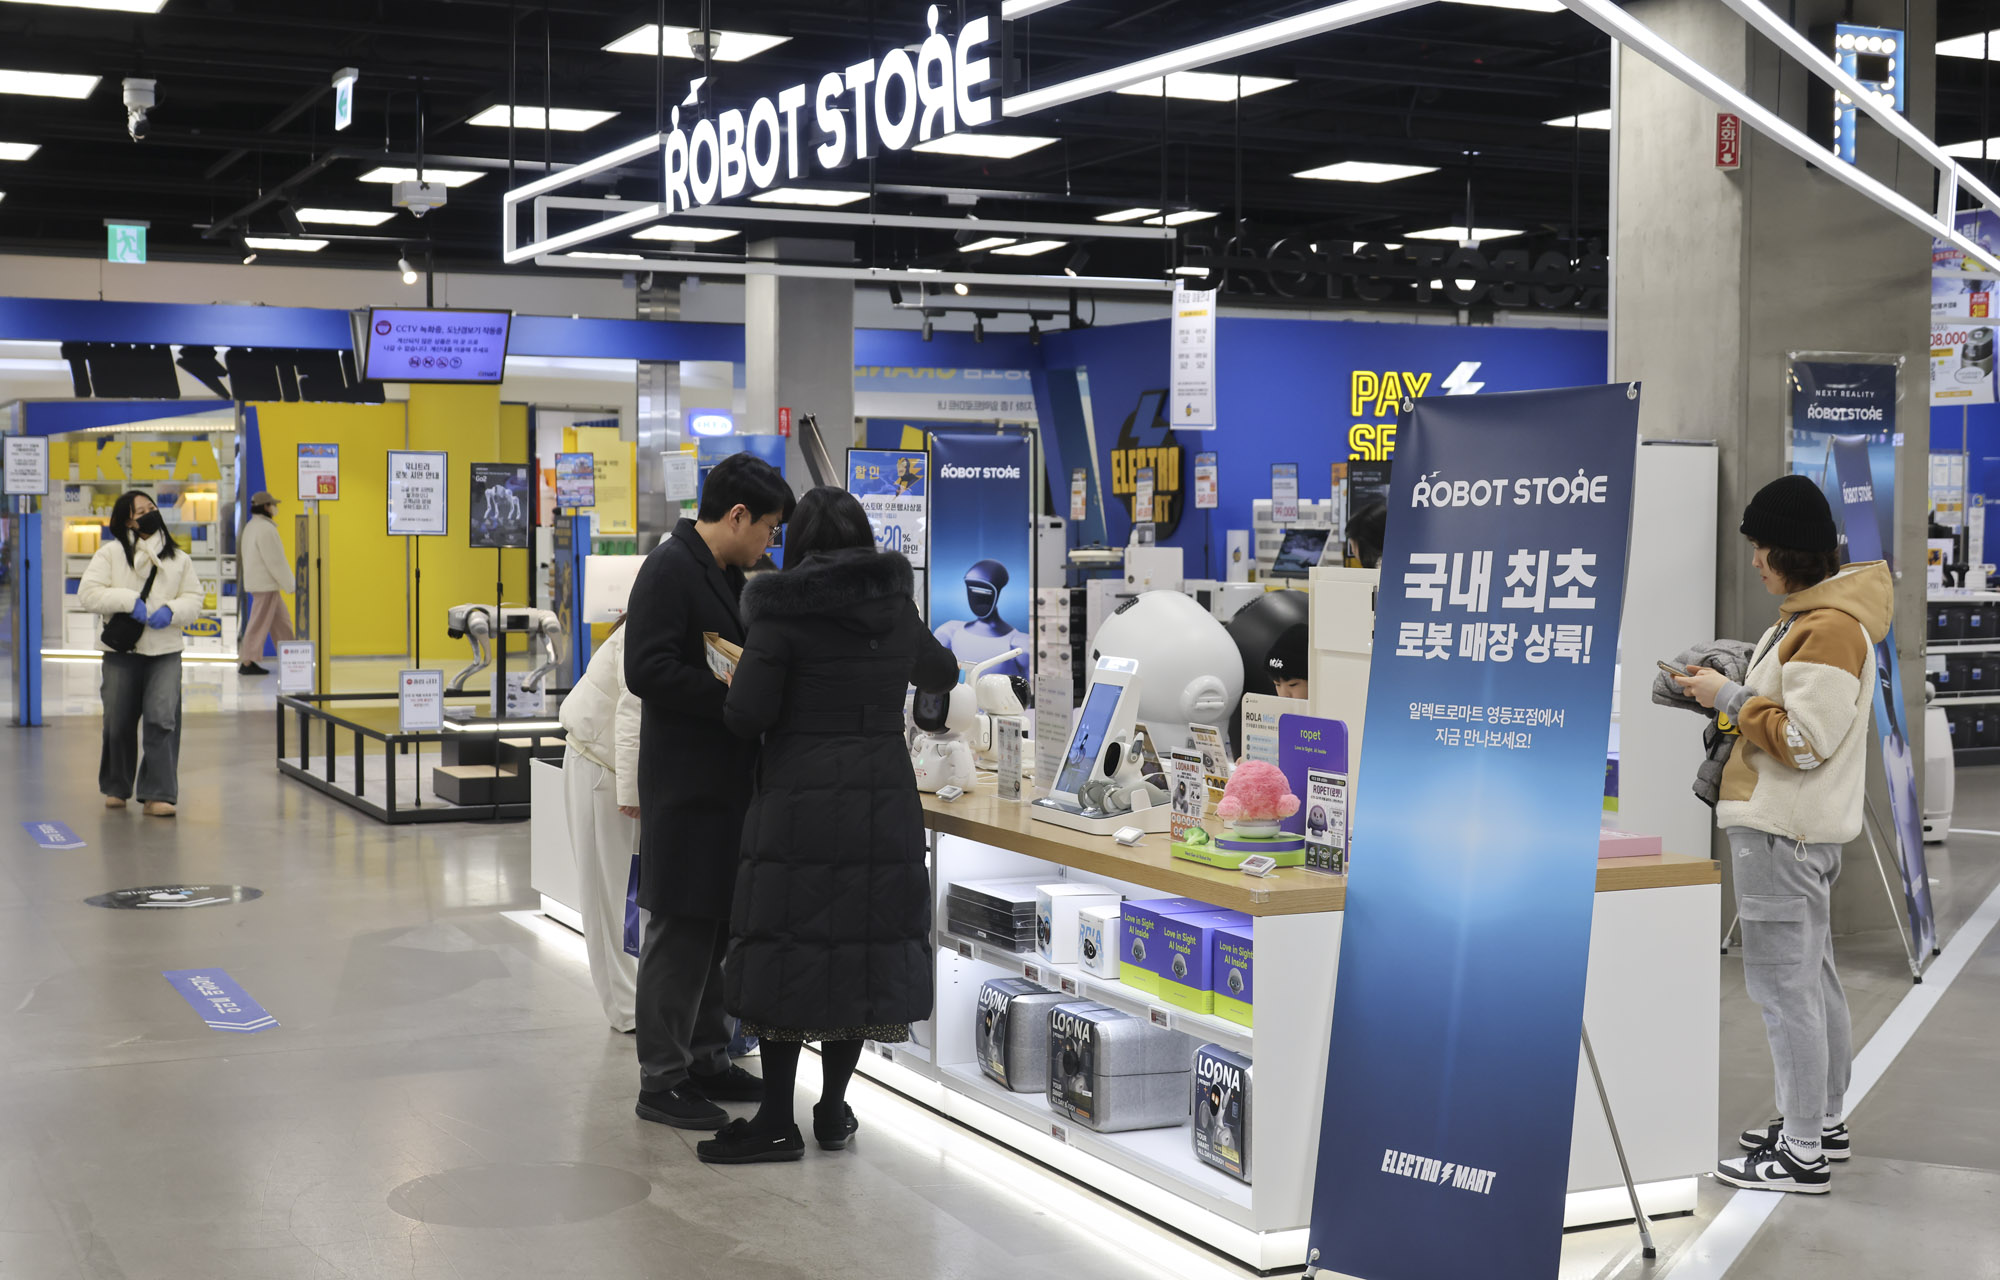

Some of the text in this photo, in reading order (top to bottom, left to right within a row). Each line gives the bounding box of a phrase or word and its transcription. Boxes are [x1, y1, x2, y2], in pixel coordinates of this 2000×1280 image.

[664, 5, 992, 213] ROBOT STORE
[1720, 115, 1737, 154] 소화기
[395, 325, 418, 333] CCTV
[1350, 370, 1432, 417] PAY
[1841, 390, 1875, 398] REALITY
[1807, 403, 1883, 421] ROBOT STORE
[50, 441, 222, 480] IKEA
[940, 463, 1021, 479] ROBOT STORE
[1411, 470, 1509, 508] ROBOT
[1513, 468, 1609, 505] STORE
[1403, 548, 1598, 614] 국내 최초
[1396, 621, 1594, 664] 로봇 매장 상륙!
[1245, 712, 1262, 722] ROLA
[1408, 702, 1566, 728] 일렉트로마트 영등포점에서
[1300, 729, 1322, 742] ropet
[1434, 728, 1533, 751] 지금 만나보세요!
[1124, 912, 1155, 931] Love in Sight
[1128, 925, 1150, 940] AI Inside
[1163, 927, 1197, 946] Love in Sight
[1168, 940, 1191, 956] AI Inside
[1219, 940, 1232, 952] Love
[1232, 946, 1238, 954] in
[1224, 954, 1248, 970] AI Inside
[980, 985, 1009, 1014] LOONA
[1052, 1009, 1090, 1043] LOONA
[1197, 1054, 1241, 1092] LOONA
[1196, 1131, 1207, 1142] YOUR
[1197, 1140, 1210, 1151] SMART
[1197, 1148, 1205, 1157] ALL
[1211, 1154, 1225, 1166] BUDDY
[1380, 1149, 1497, 1195] ELECTRO MART
